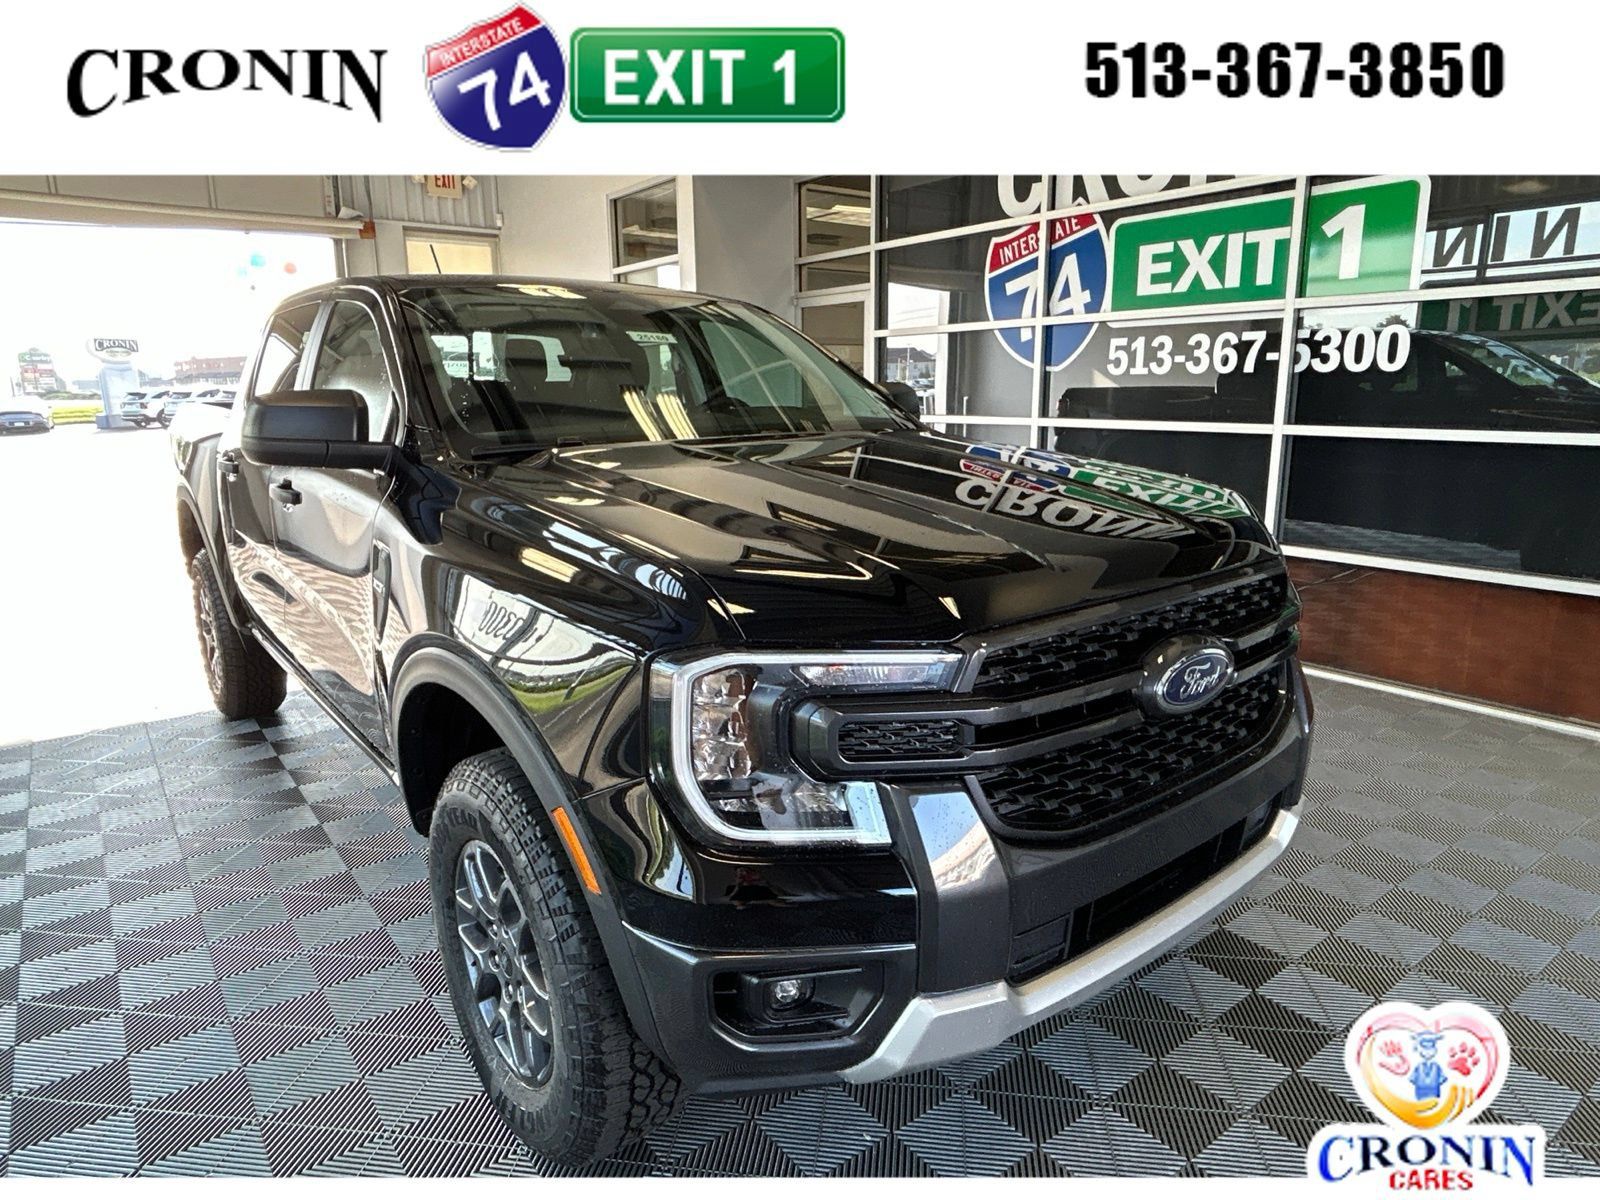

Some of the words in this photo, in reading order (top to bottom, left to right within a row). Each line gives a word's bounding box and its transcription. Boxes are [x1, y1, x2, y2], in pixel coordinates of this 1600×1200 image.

[434, 174, 456, 189] EXIT
[1000, 217, 1081, 265] INTERATE
[1136, 226, 1291, 297] EXIT
[1321, 204, 1367, 280] 1
[1005, 253, 1092, 342] 74
[95, 339, 138, 352] CRONIN
[1106, 324, 1411, 375] 513-367-5300
[1180, 662, 1220, 700] Ford
